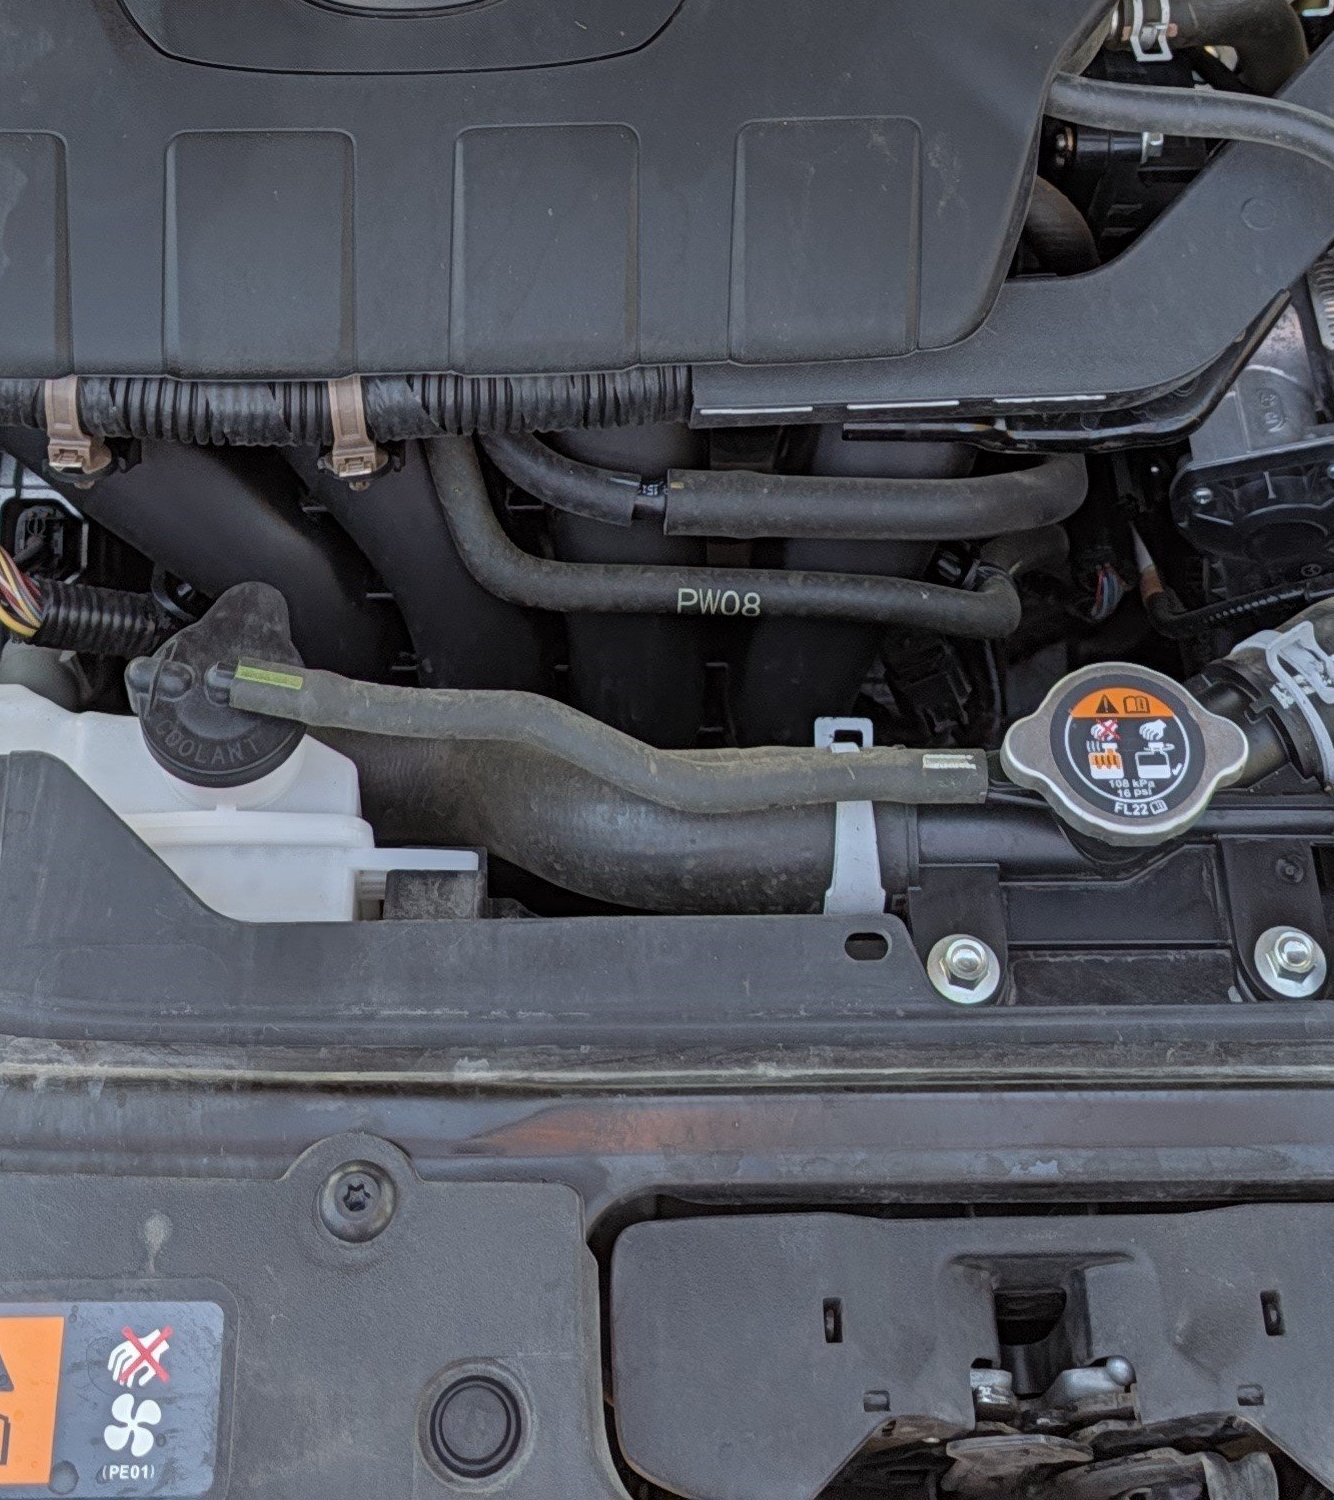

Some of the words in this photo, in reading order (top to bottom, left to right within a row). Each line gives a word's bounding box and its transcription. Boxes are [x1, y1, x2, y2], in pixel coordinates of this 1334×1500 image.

[155, 719, 260, 766] COOLANT
[1114, 801, 1150, 816] FL22
[102, 1464, 155, 1480] (PE01)
